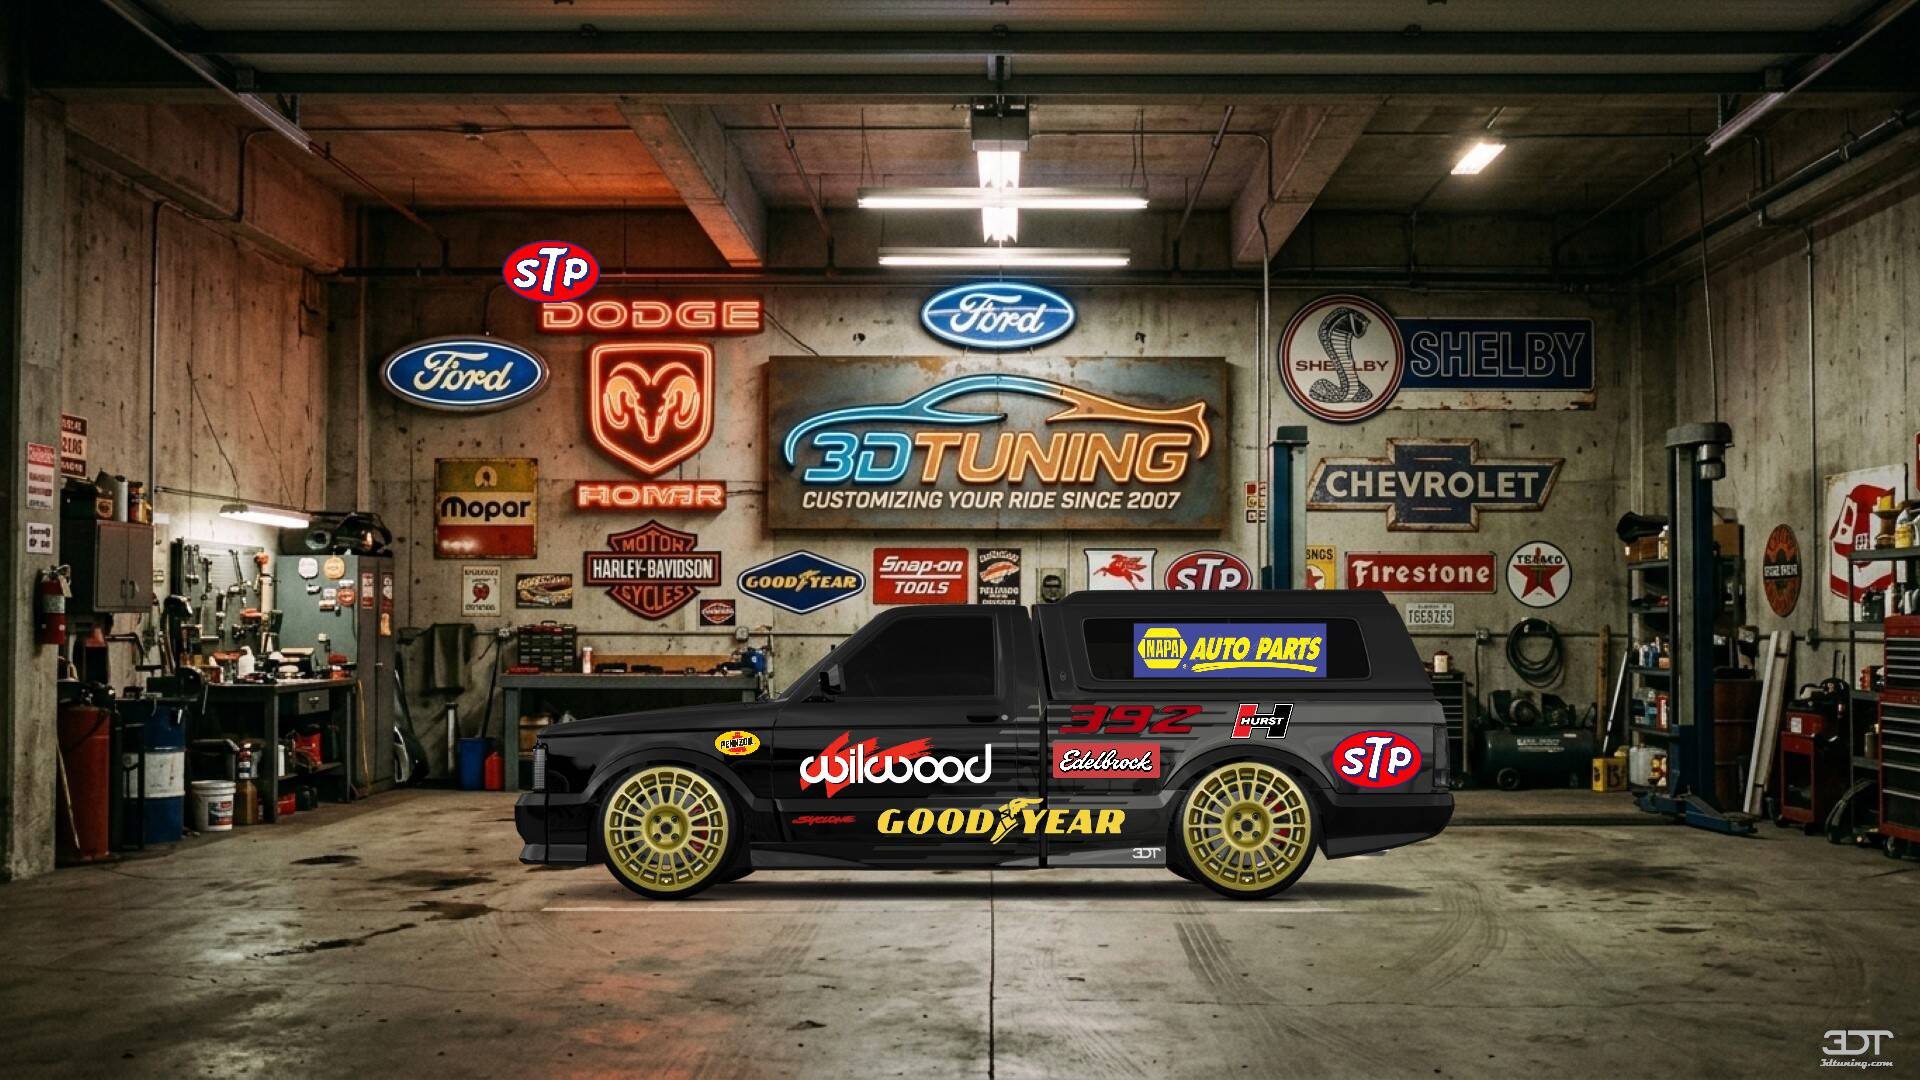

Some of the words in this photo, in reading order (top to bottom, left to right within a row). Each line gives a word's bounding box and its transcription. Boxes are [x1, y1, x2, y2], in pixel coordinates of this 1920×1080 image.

[513, 246, 589, 295] STP
[542, 300, 761, 330] DODGE
[950, 293, 1048, 334] Ford
[1295, 359, 1390, 372] SHELBY
[1410, 330, 1586, 378] SHELBY
[412, 350, 514, 392] Ford
[804, 431, 1193, 484] 3DTUNING
[1325, 470, 1539, 499] CHEVROLET
[802, 491, 942, 509] CUSTOMIZING
[949, 491, 1005, 509] YOUR
[1008, 491, 1056, 509] RIDE
[1060, 491, 1124, 509] SINCE
[1127, 491, 1181, 509] 2007
[879, 556, 964, 576] Snap-on
[1175, 558, 1242, 590] STP
[1352, 560, 1490, 588] Firestone
[894, 581, 950, 595] TOOLS
[1146, 639, 1180, 659] NAPA
[1189, 637, 1251, 661] AUTO
[1255, 637, 1323, 661] PARTS
[1057, 704, 1204, 734] 392
[1240, 716, 1285, 726] HURST
[1059, 749, 1154, 773] Edelbrock
[1341, 736, 1415, 782] STP
